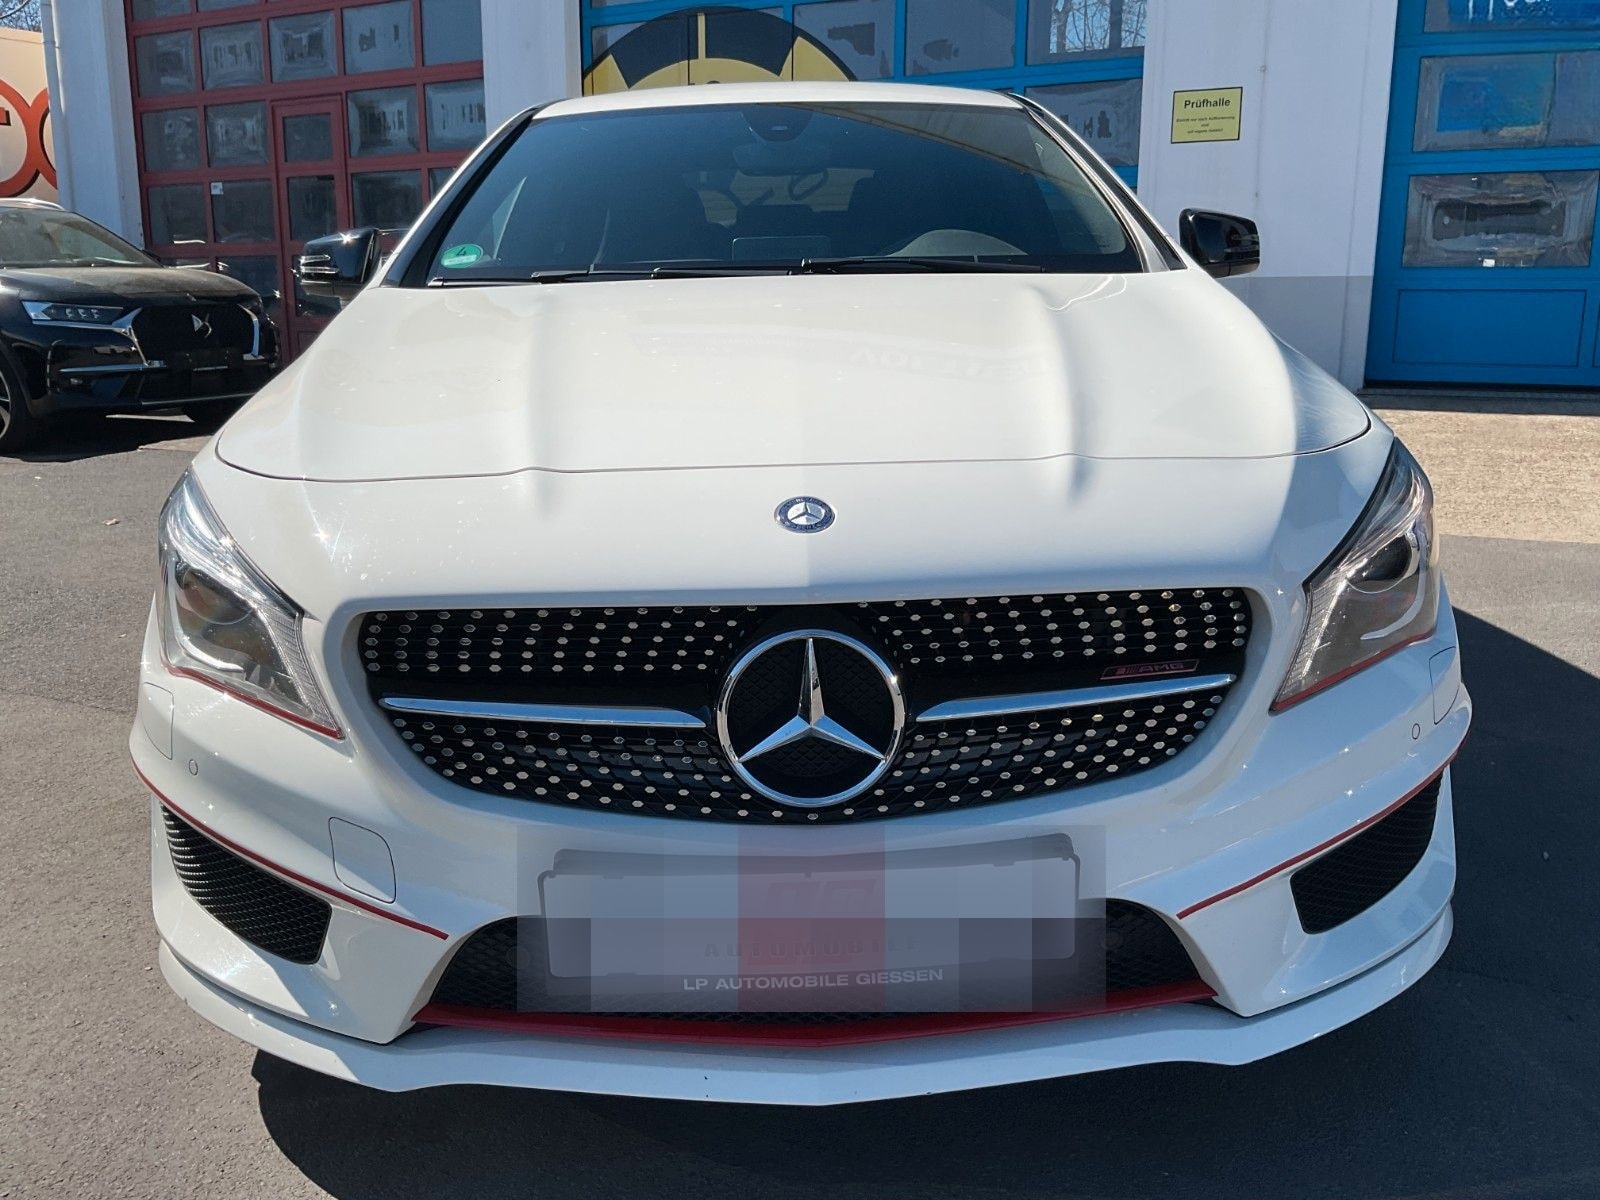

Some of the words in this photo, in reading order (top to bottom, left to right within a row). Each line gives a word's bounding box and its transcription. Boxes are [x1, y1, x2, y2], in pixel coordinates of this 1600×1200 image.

[1184, 97, 1231, 109] Prüfhalle
[456, 246, 467, 256] 4
[683, 978, 708, 991] LP
[715, 974, 849, 991] AUTOMOBILE
[855, 968, 943, 985] GIESSEN
